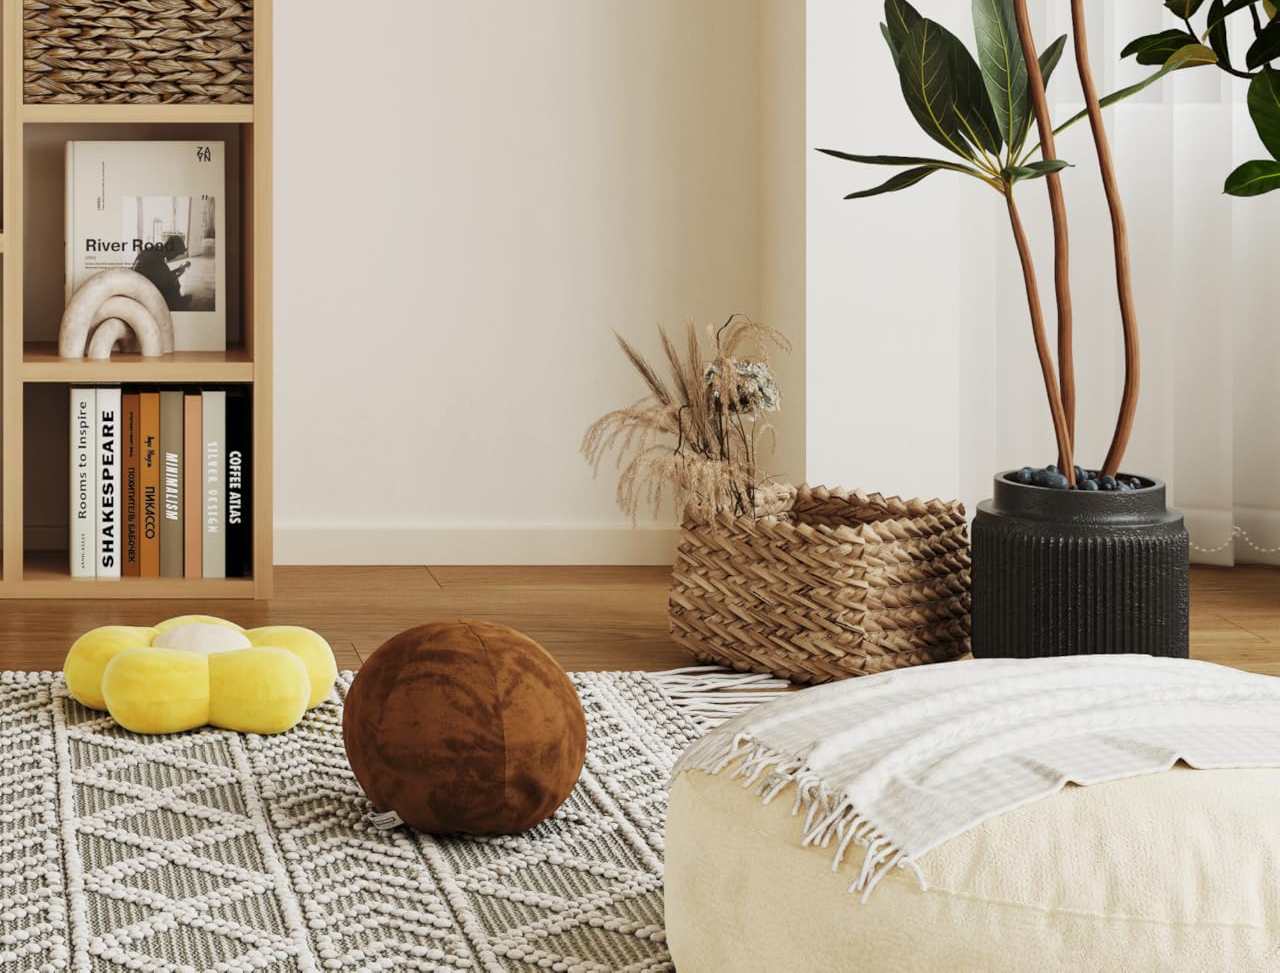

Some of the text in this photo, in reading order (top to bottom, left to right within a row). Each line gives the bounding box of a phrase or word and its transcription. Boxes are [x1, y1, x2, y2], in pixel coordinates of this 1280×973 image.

[85, 238, 174, 252] River Road
[77, 401, 90, 519] Rooms to Inspire
[102, 410, 114, 568] SHAKESPEARE
[165, 452, 178, 521] MINIMALISM
[207, 441, 219, 533] SILVER DESIGN
[229, 450, 242, 525] COFFEE ATLAS
[145, 486, 155, 540] ПИКАССО
